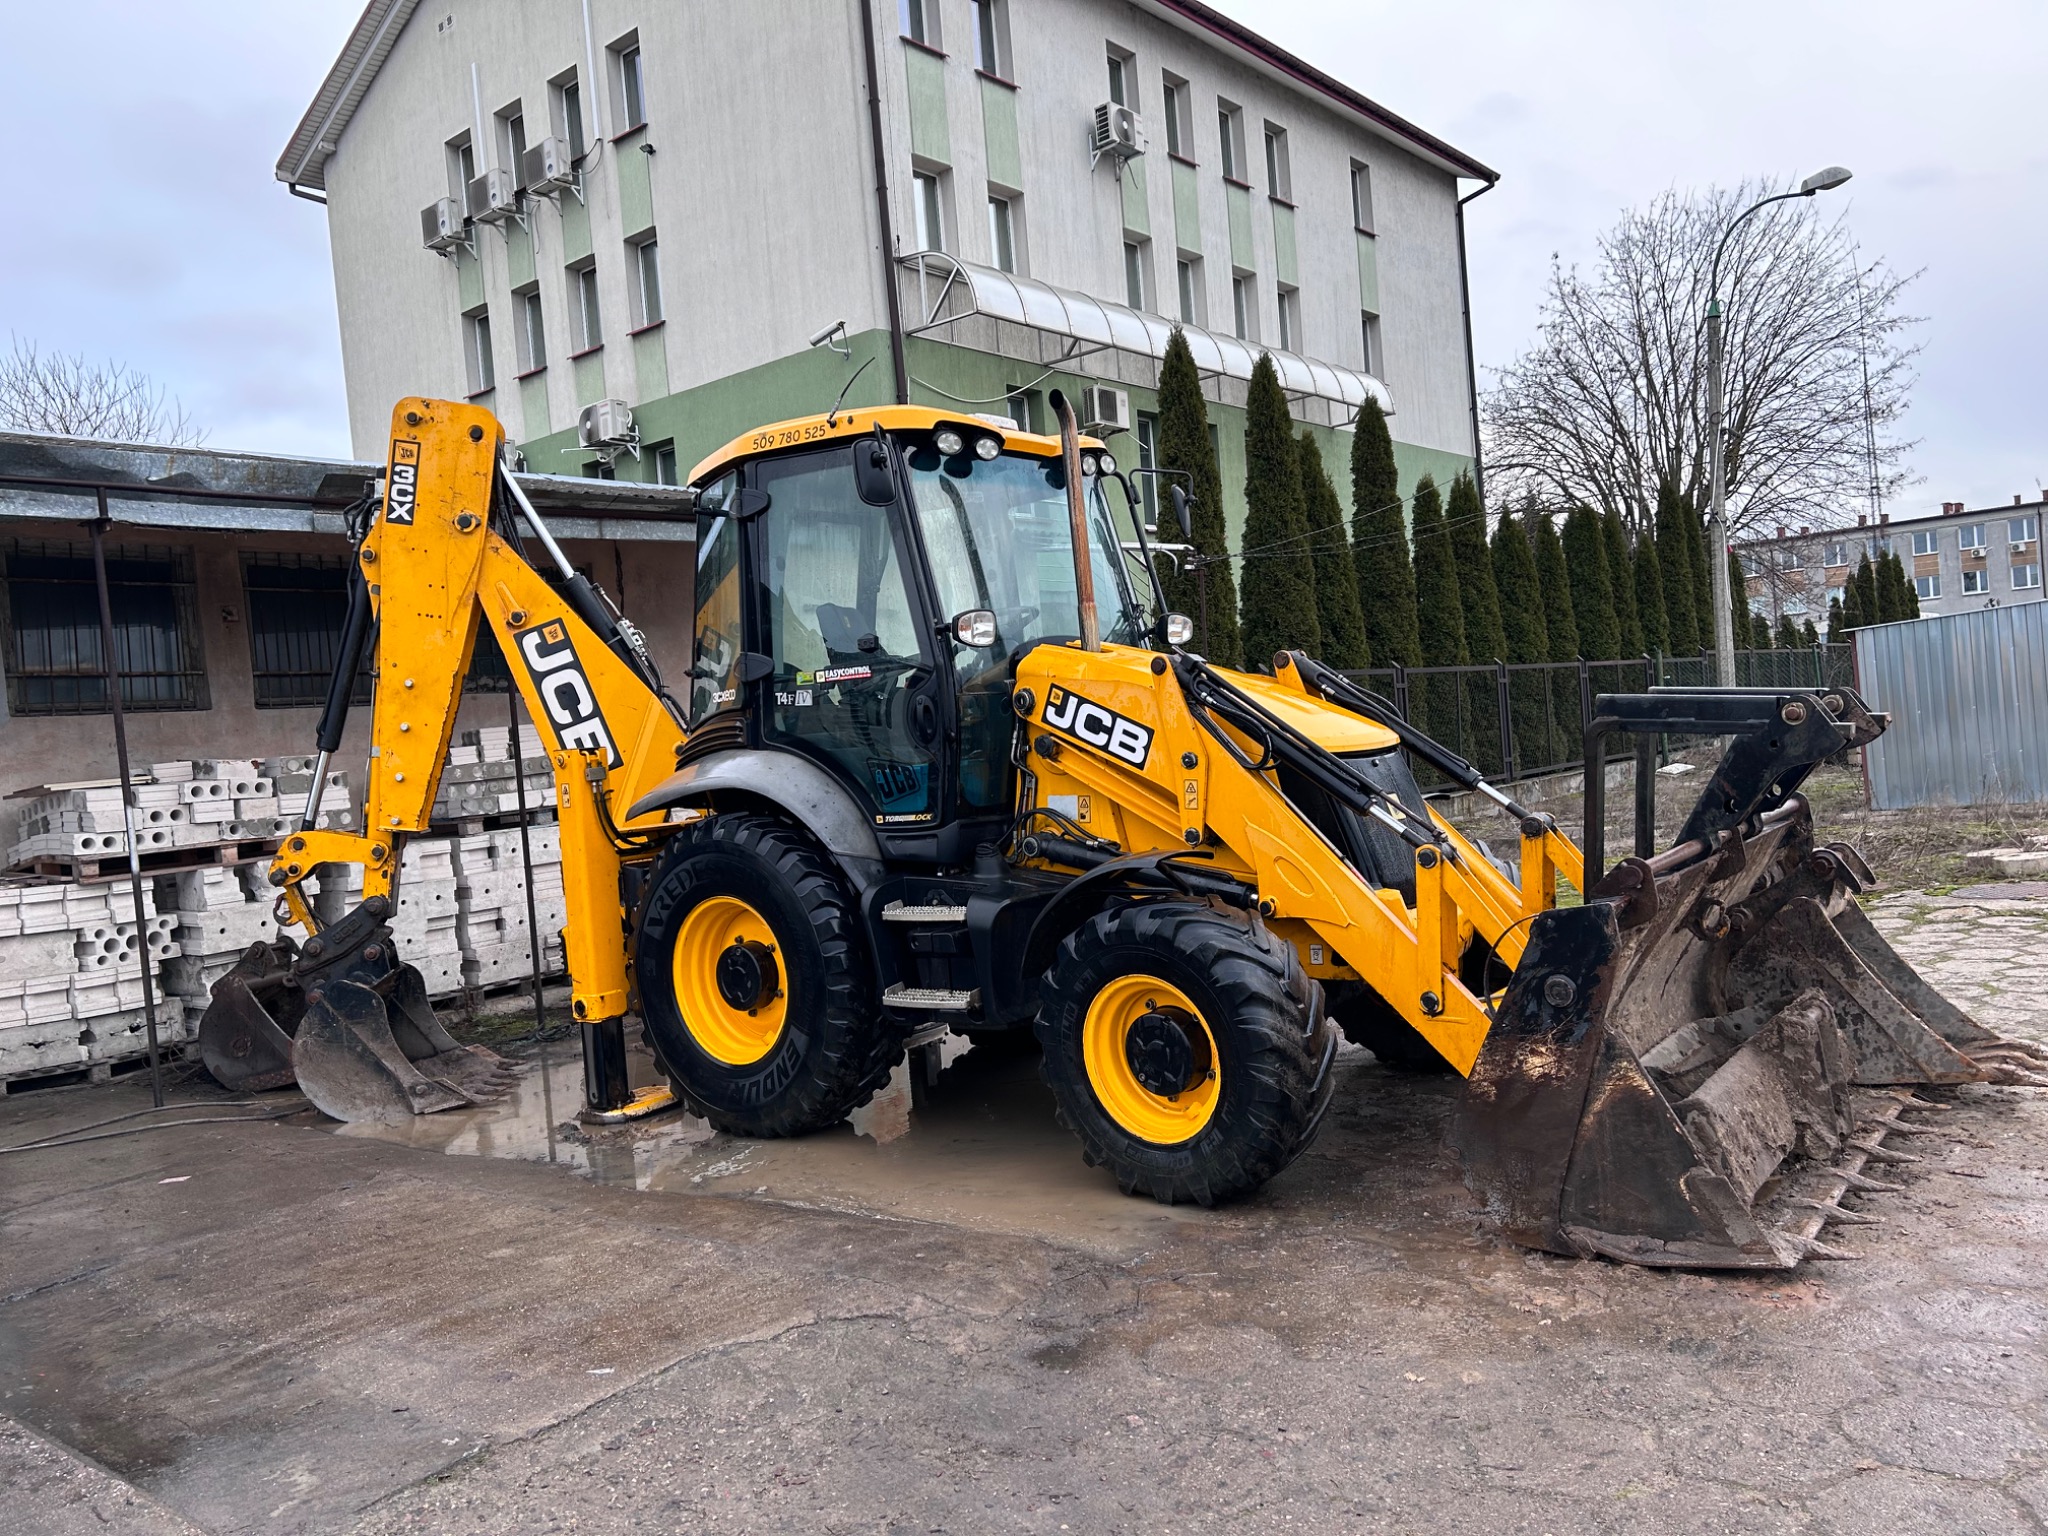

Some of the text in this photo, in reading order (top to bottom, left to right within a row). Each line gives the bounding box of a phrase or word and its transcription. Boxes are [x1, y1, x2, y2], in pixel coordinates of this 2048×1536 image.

[752, 424, 826, 450] 509 780 525
[388, 465, 415, 521] 3CX
[825, 665, 871, 678] EASYCONTROL
[1045, 695, 1149, 764] JCB
[877, 763, 917, 799] JCB
